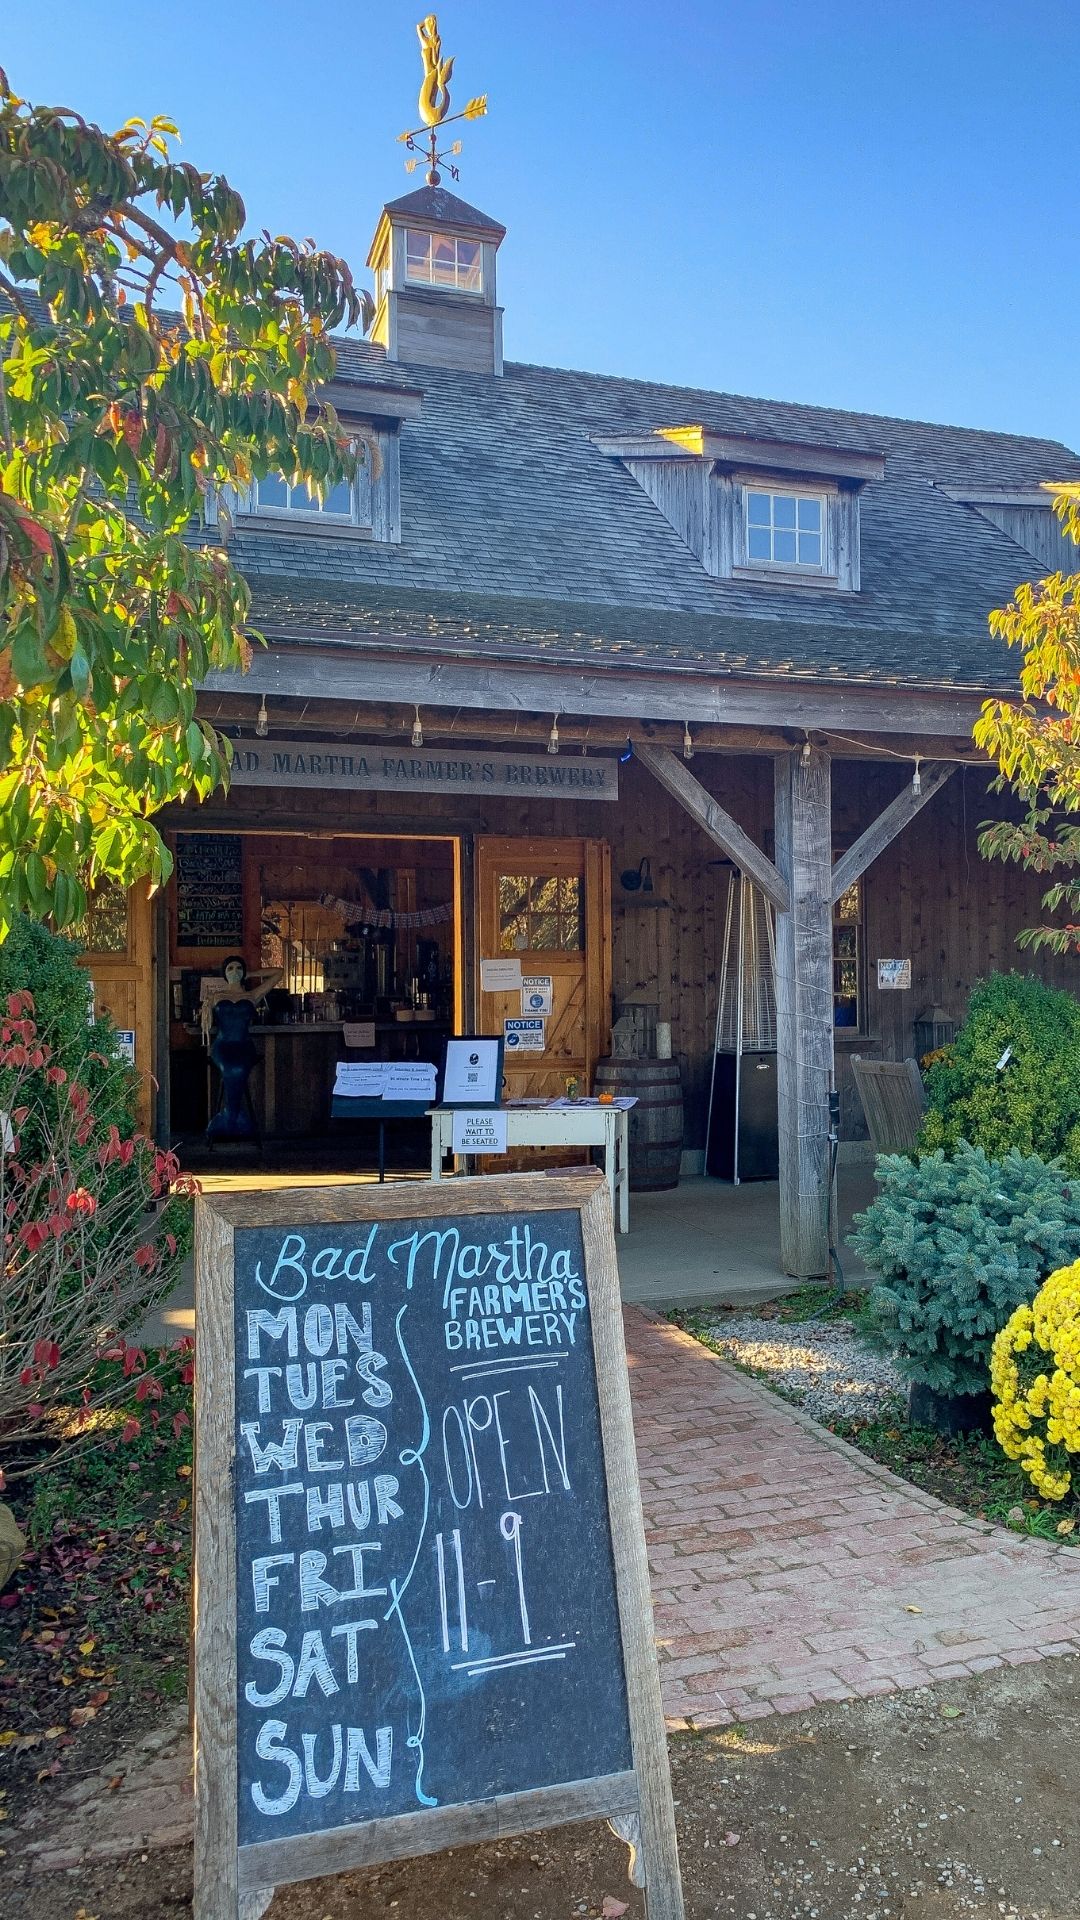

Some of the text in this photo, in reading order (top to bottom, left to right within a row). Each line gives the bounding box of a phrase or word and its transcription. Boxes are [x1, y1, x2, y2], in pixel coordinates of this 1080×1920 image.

[231, 751, 605, 788] AD MARTHA FARMER'S BREWERY
[523, 978, 550, 986] NOTICE
[507, 1021, 541, 1029] NOTICE
[255, 1223, 580, 1310] Bad Martha
[450, 1277, 587, 1320] FARMER'S
[246, 1302, 374, 1359] MON
[444, 1313, 577, 1350] BREWERY
[244, 1351, 393, 1413] TUES
[240, 1414, 388, 1473] WED
[443, 1385, 571, 1509] OPEN
[244, 1474, 405, 1544] THUR
[252, 1542, 388, 1613] FRI
[245, 1619, 379, 1708] SAT
[251, 1719, 393, 1816] SUN
